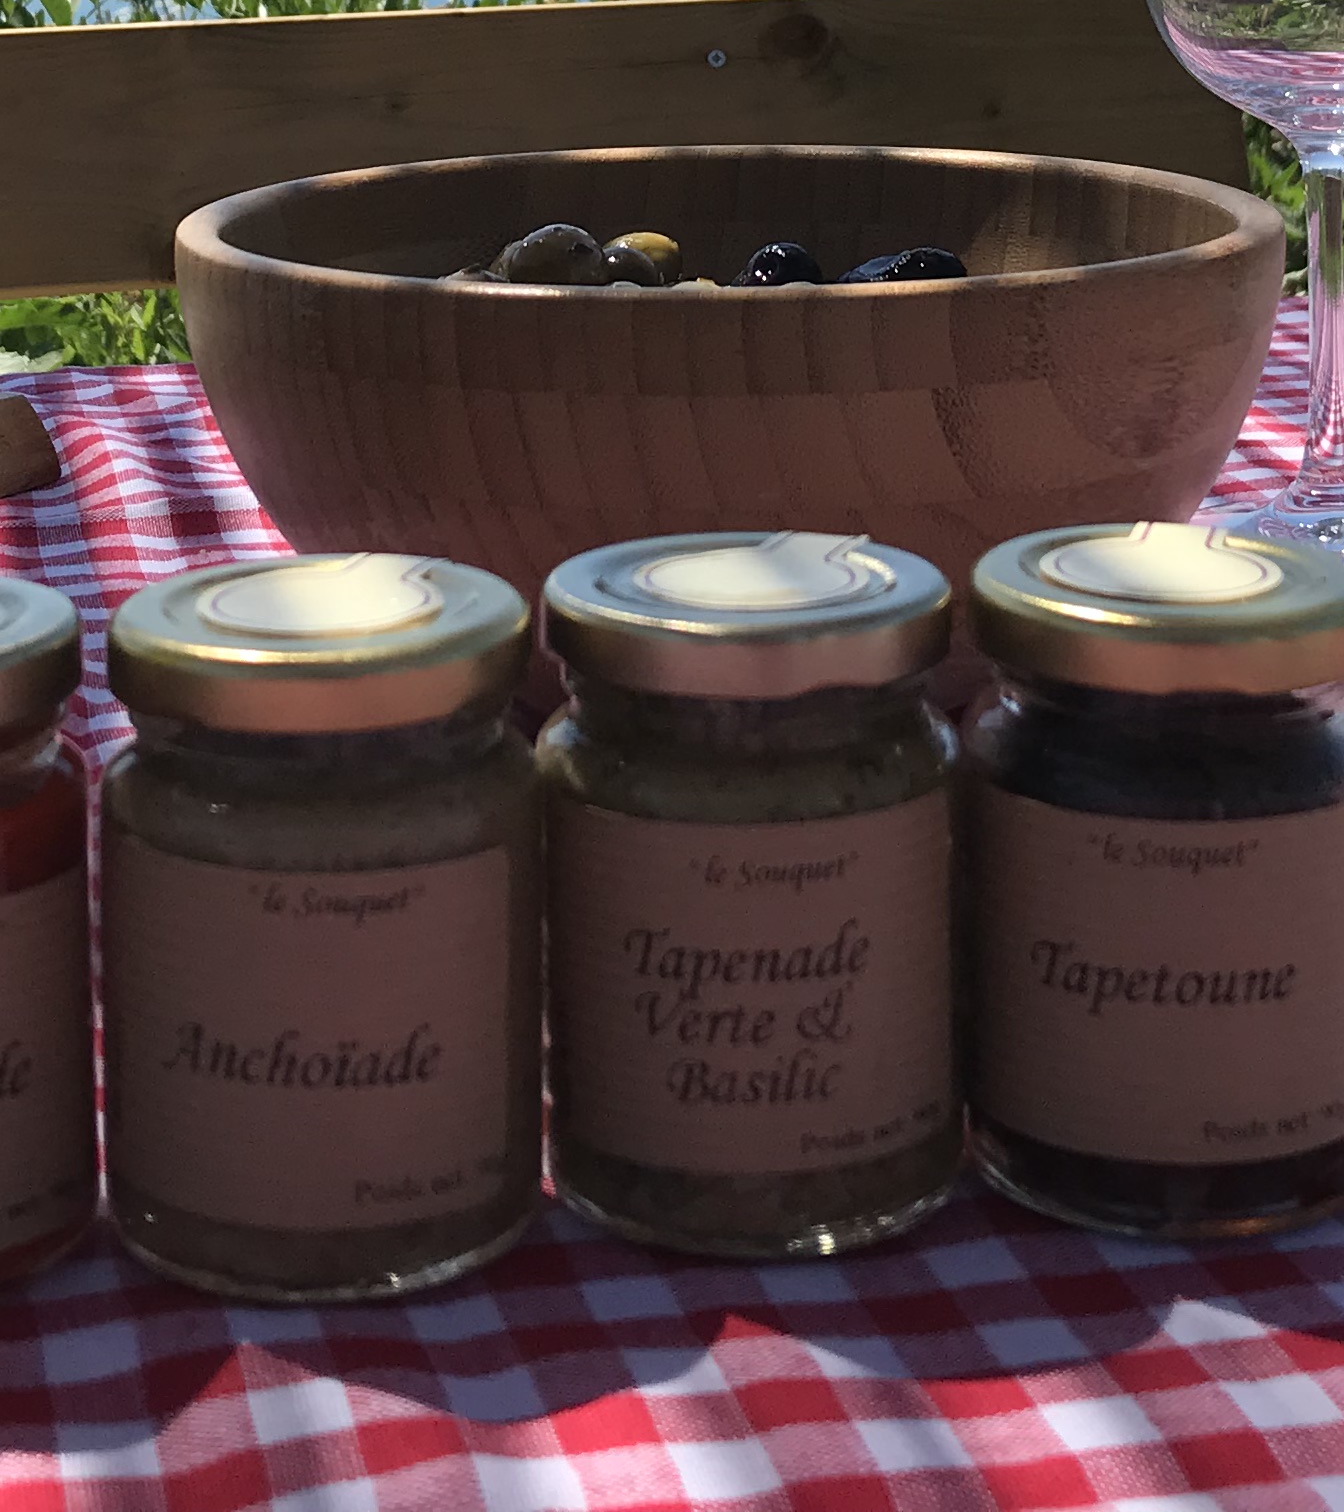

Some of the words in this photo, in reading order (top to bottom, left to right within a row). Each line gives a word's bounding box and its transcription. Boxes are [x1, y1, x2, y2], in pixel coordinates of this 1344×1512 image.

[623, 916, 870, 1000] Tapenade
[1029, 939, 1297, 1017] Tapetoune
[634, 988, 776, 1047] Verte
[796, 980, 854, 1044] &
[160, 1020, 443, 1090] Anchoïade
[666, 1048, 844, 1105] Basilic
